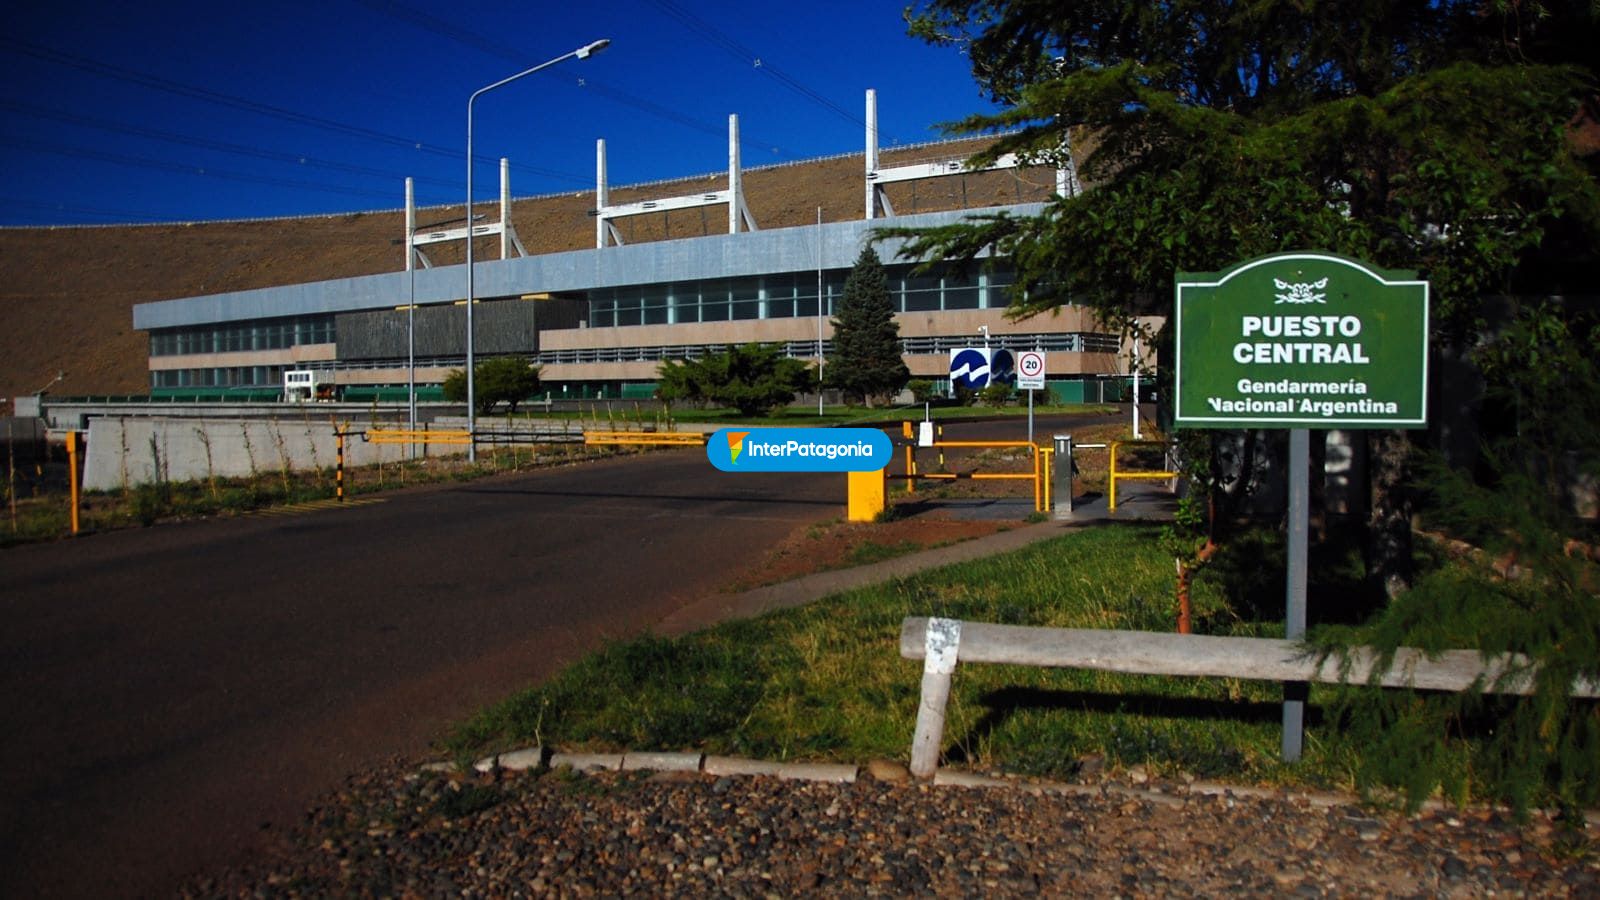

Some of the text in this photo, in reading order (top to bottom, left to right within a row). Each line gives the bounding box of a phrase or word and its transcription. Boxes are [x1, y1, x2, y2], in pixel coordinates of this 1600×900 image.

[1242, 315, 1361, 337] PUESTO
[1233, 343, 1370, 364] CENTRAL
[1025, 360, 1038, 369] 20
[1237, 378, 1367, 394] Gendarmería
[1207, 397, 1398, 416] Nacional Argentina
